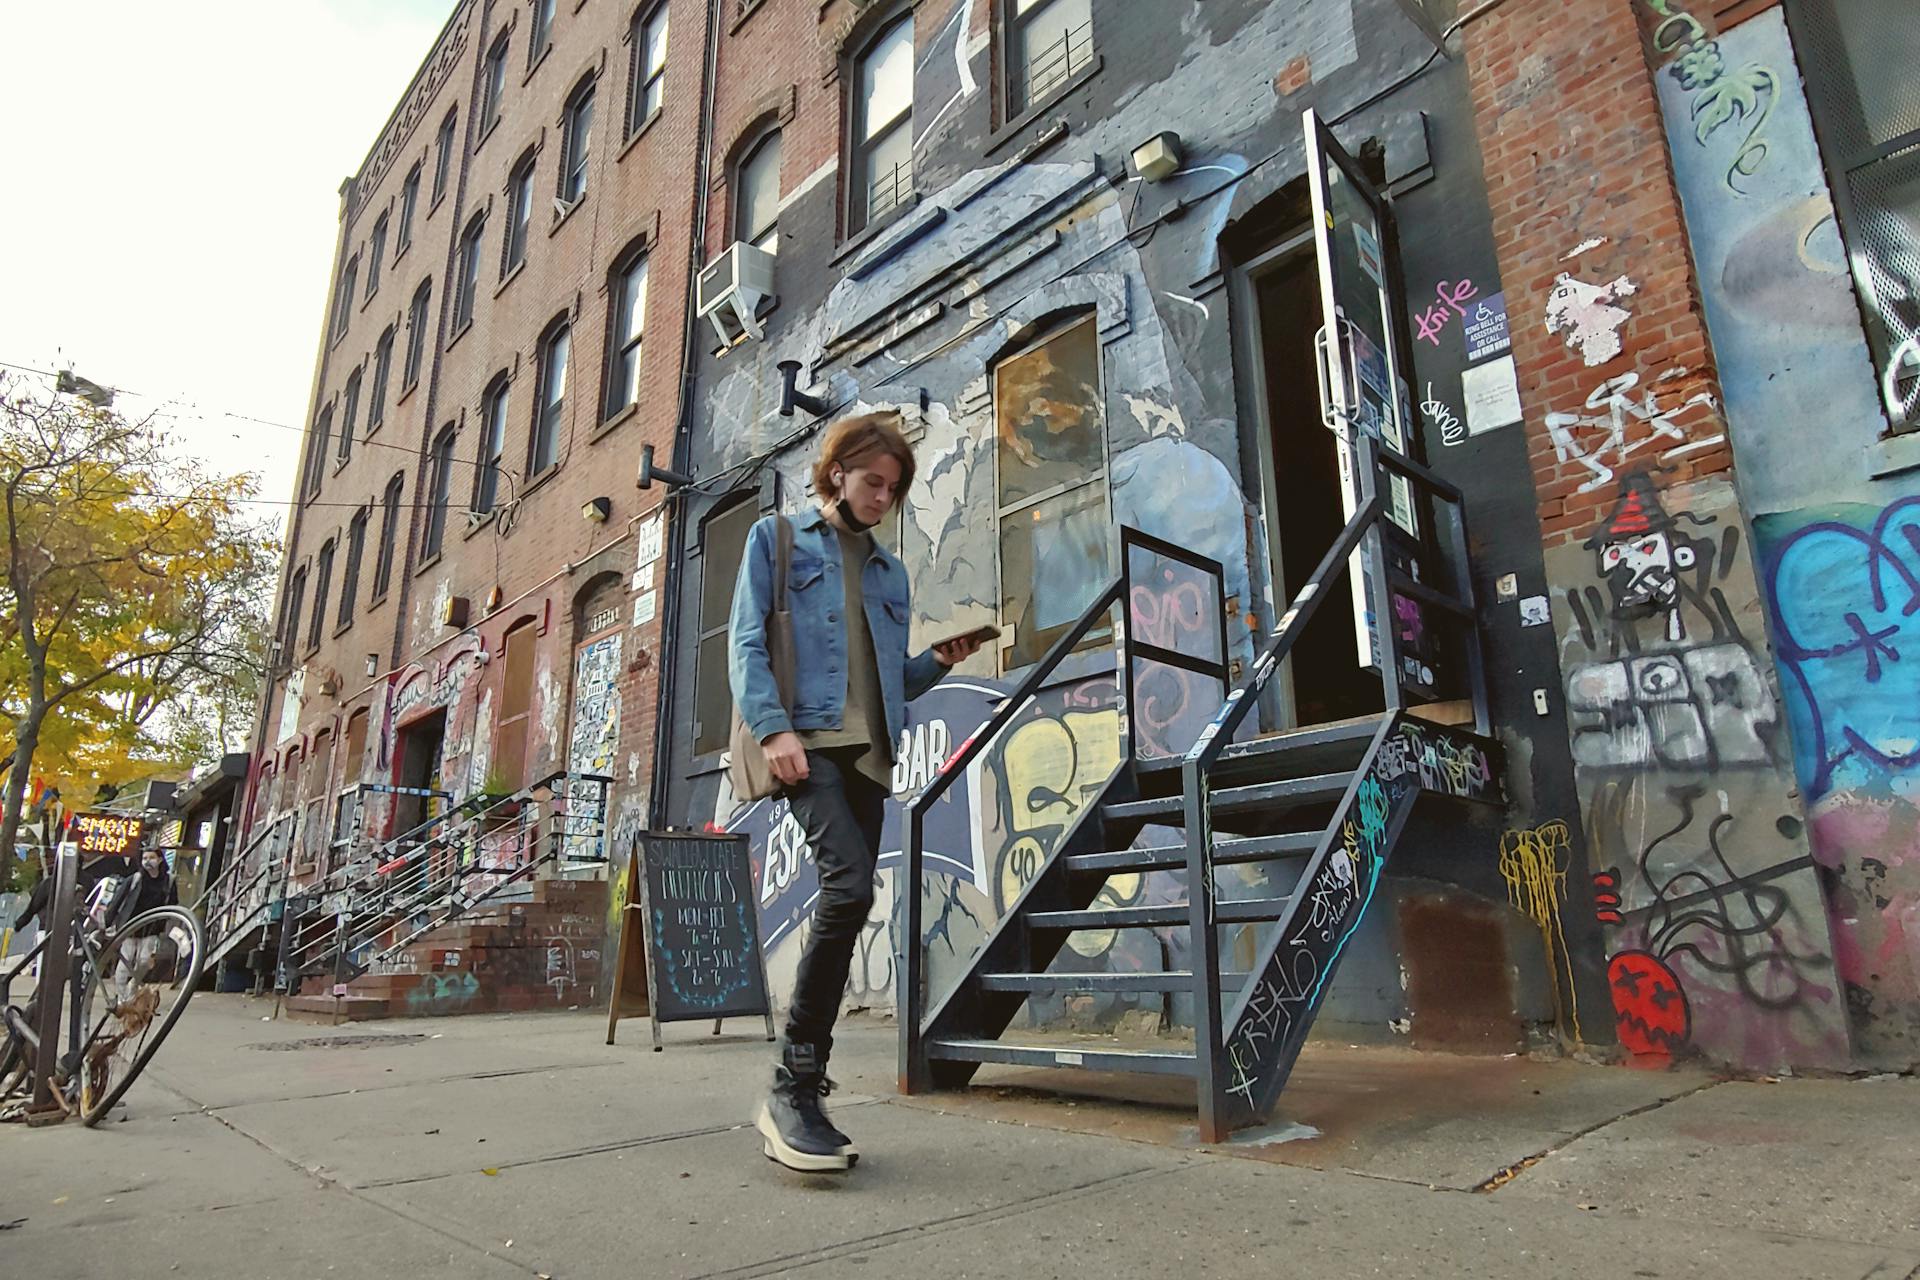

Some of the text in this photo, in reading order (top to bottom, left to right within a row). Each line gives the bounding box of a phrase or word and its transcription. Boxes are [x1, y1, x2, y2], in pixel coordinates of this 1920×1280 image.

[1465, 312, 1507, 336] RING BELL FOR
[1470, 322, 1505, 342] ASSISTANCE
[1477, 333, 1500, 348] OR CALL
[892, 718, 948, 794] BAR
[768, 804, 781, 825] 49
[78, 816, 141, 837] SMOKE
[82, 836, 128, 854] SHOP
